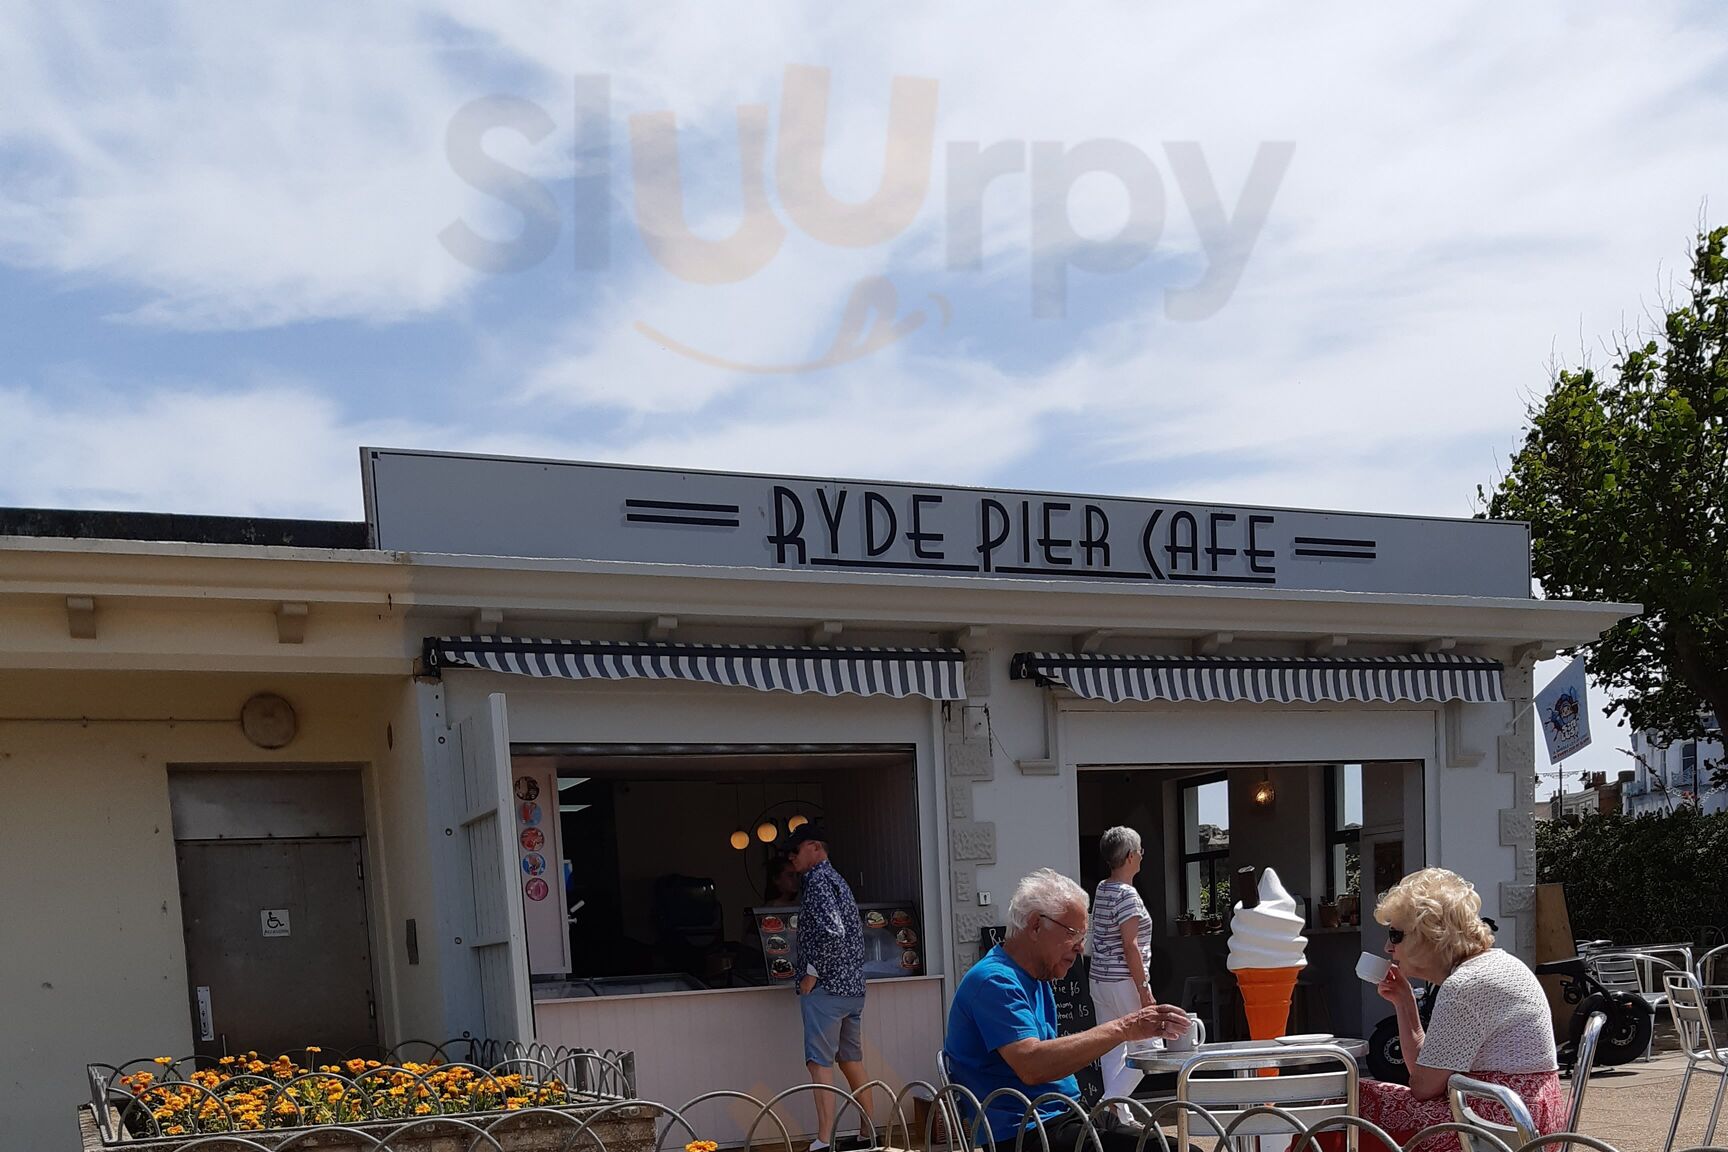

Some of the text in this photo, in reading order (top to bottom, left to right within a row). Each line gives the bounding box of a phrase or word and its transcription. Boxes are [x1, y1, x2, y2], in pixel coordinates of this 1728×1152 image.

[767, 485, 1276, 580] RYDE PIER CAFE
